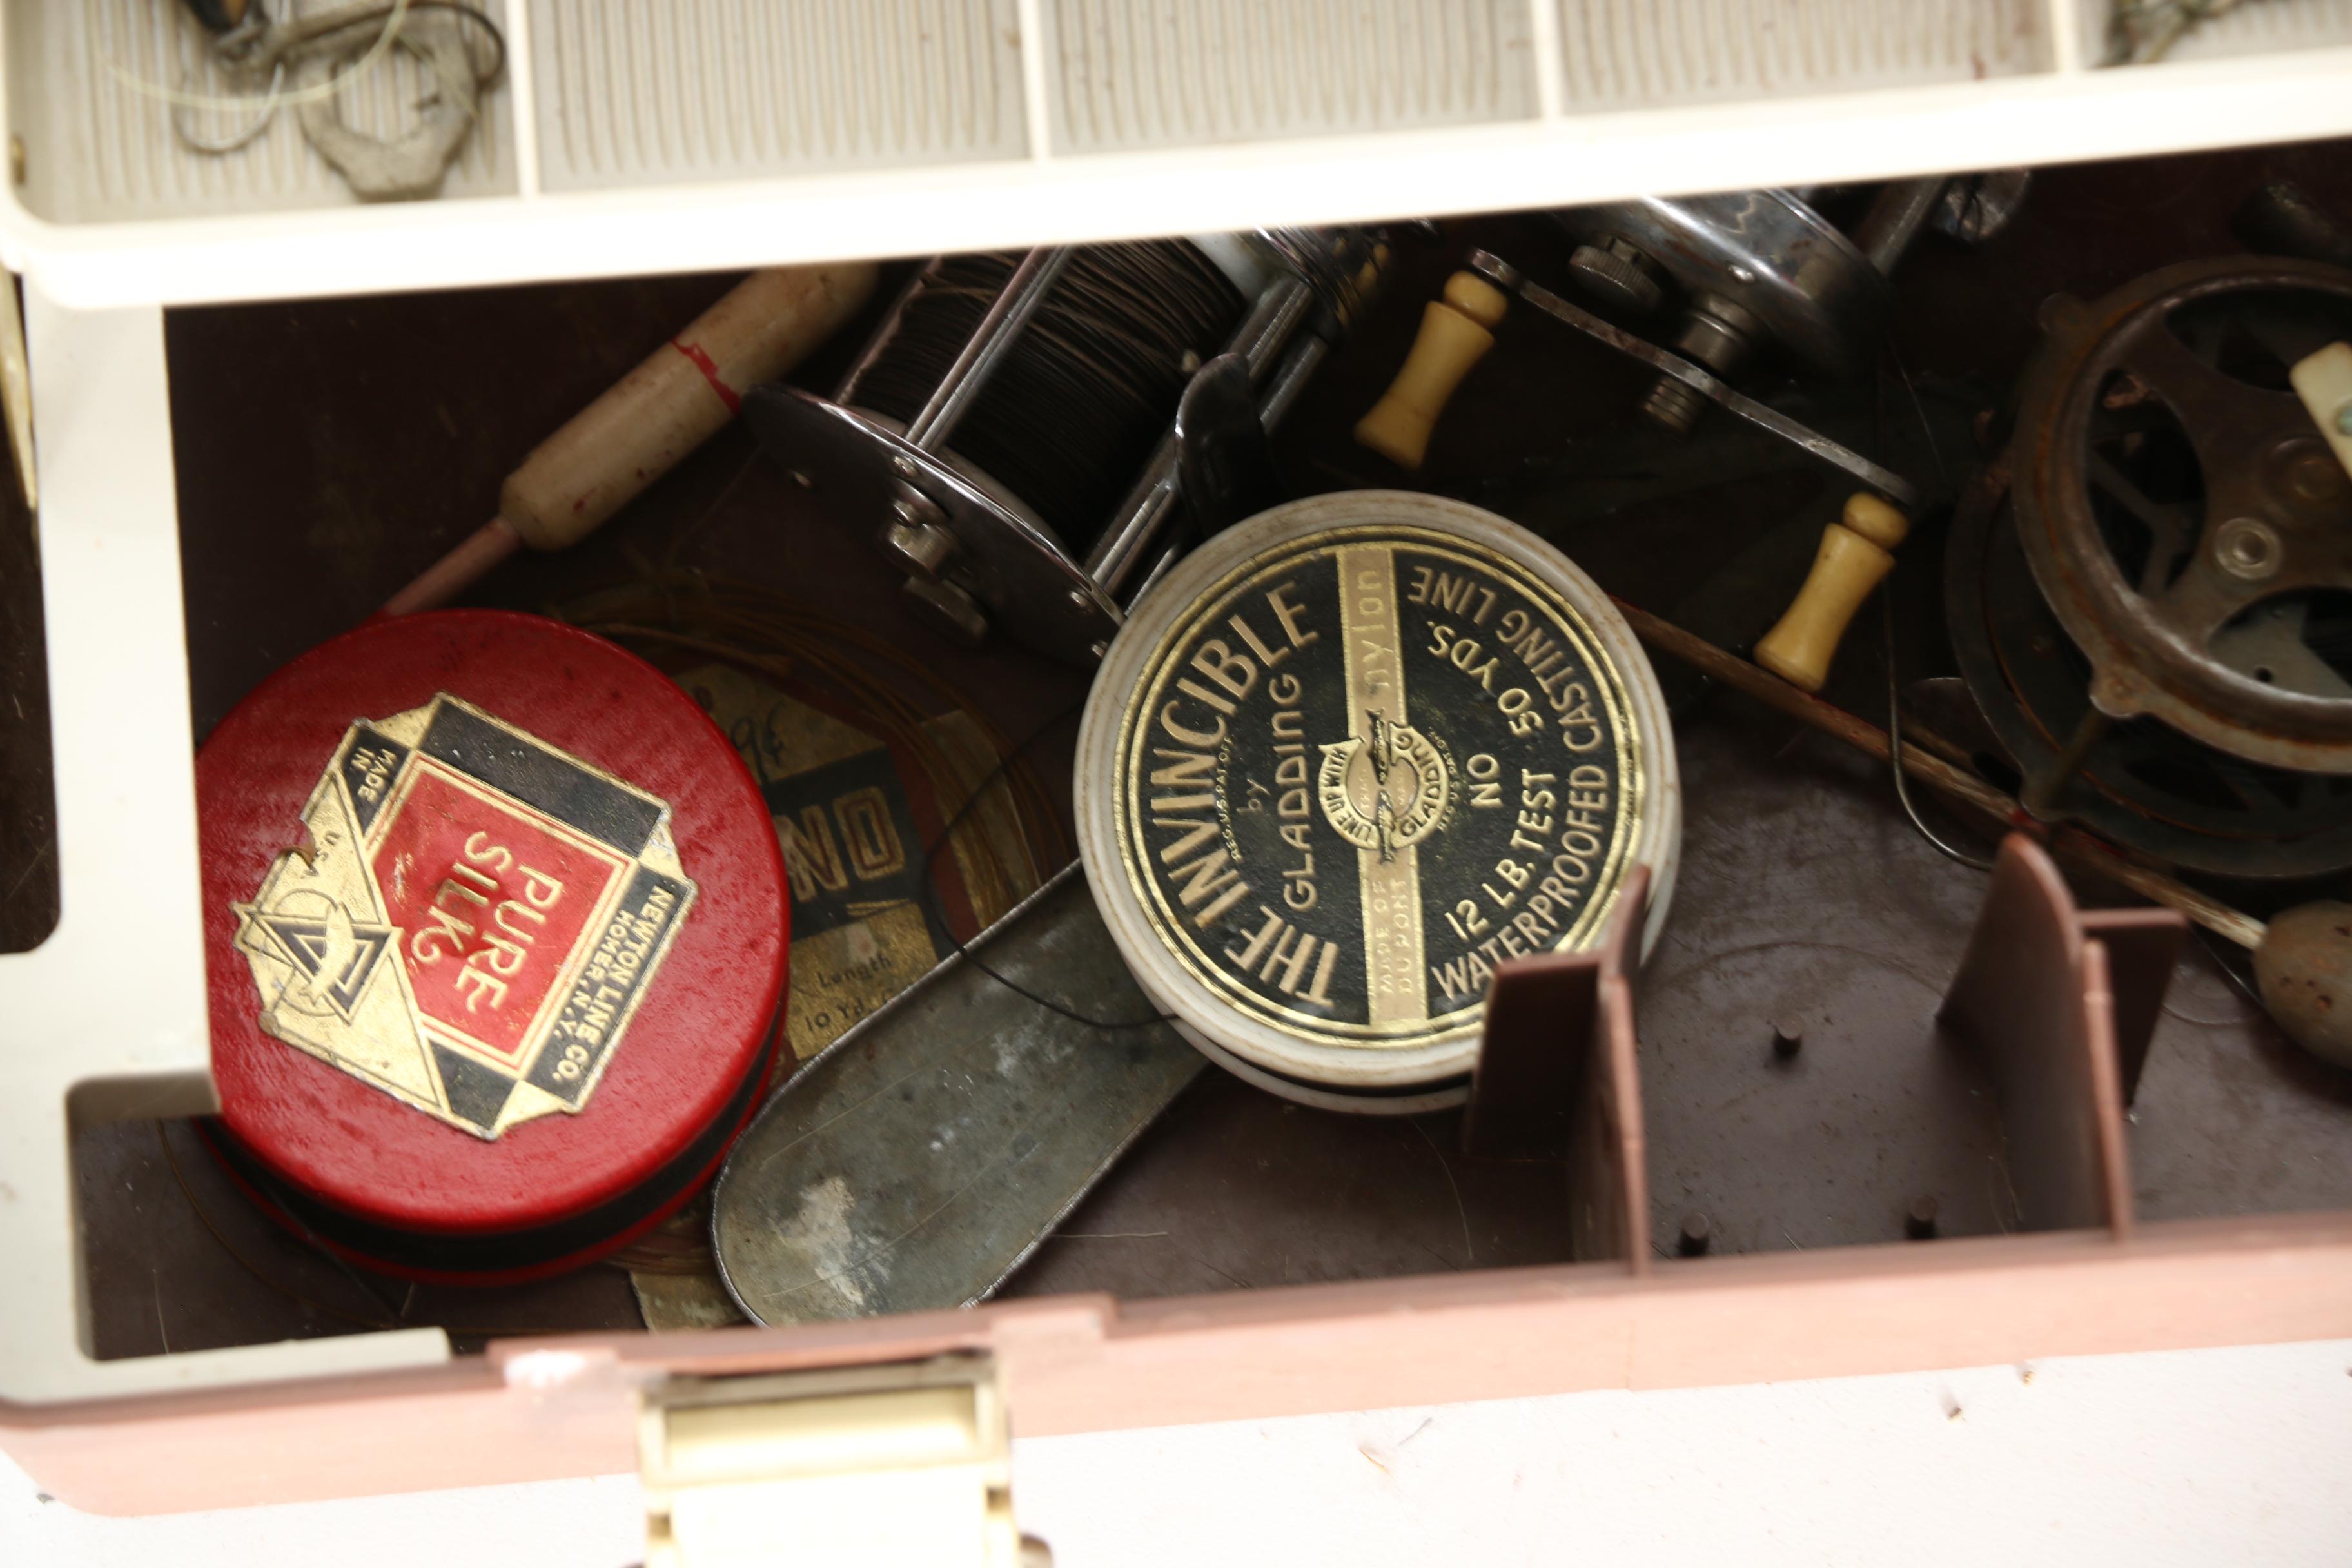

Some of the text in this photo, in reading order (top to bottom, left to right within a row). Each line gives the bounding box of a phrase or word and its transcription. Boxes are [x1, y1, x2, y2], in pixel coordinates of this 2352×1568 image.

[1357, 571, 1389, 691] nylon
[1428, 620, 1498, 689] YDS.
[351, 745, 378, 770] IN
[1498, 689, 1543, 738] 50
[358, 748, 398, 803] MADE
[1151, 582, 1337, 1007] THE INVINCIBLE
[1237, 778, 1270, 812] by
[1270, 674, 1315, 910] GLADDING
[1324, 748, 1371, 842] LINE UP WITH
[1395, 732, 1442, 838] GLADDING
[1408, 567, 1609, 1001] WATERPROOFED CASTING LINE
[1469, 754, 1500, 808] NO
[1511, 768, 1555, 855] TEST
[411, 830, 512, 965] SILK
[455, 863, 563, 1014] PURE
[1372, 880, 1394, 994] MADE OF
[1446, 899, 1490, 941] 12
[552, 884, 676, 1083] NEWTON LINE CO.
[816, 952, 894, 988] Length
[804, 1010, 832, 1032] 10
